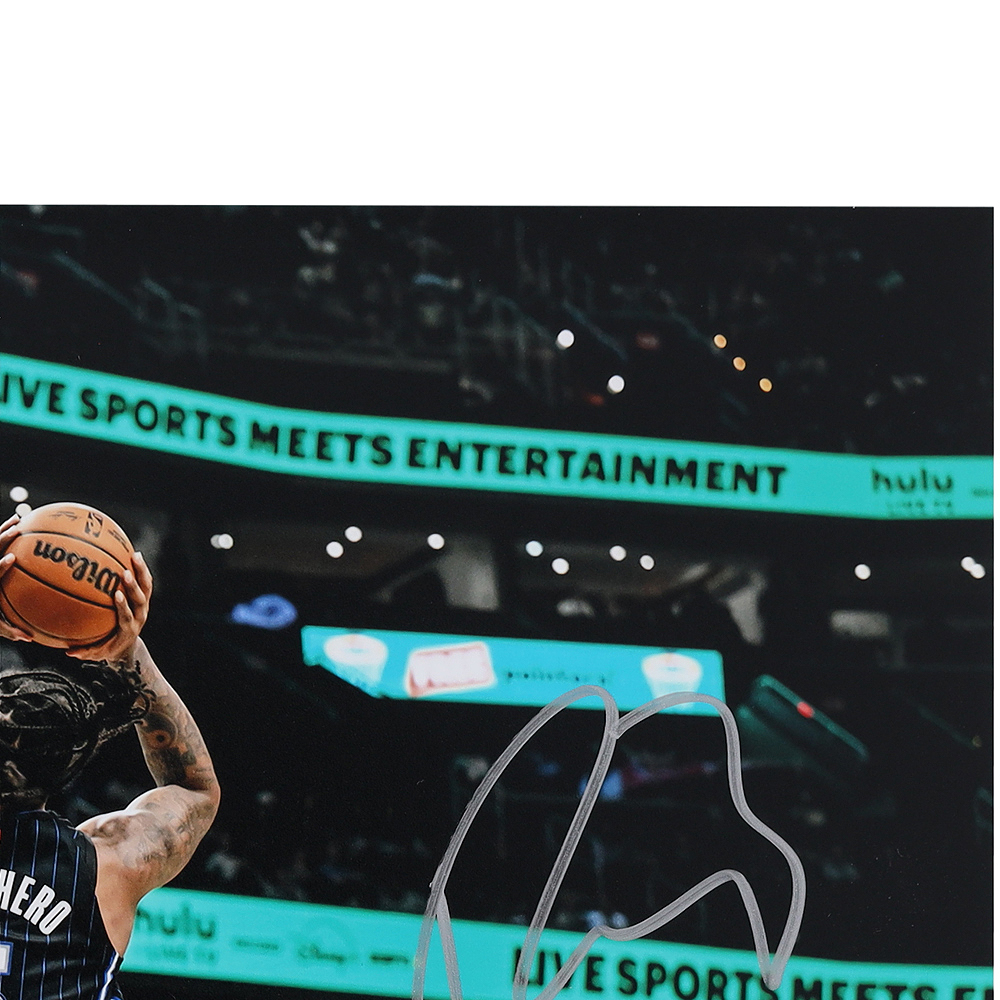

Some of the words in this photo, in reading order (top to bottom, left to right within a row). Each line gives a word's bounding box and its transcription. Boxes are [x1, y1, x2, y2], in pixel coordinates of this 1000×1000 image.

[80, 388, 236, 447] SPORTS
[251, 420, 393, 466] MEETS
[407, 438, 787, 496] ENTERTAINMENT
[872, 467, 954, 494] hulu
[32, 540, 121, 598] Wilson
